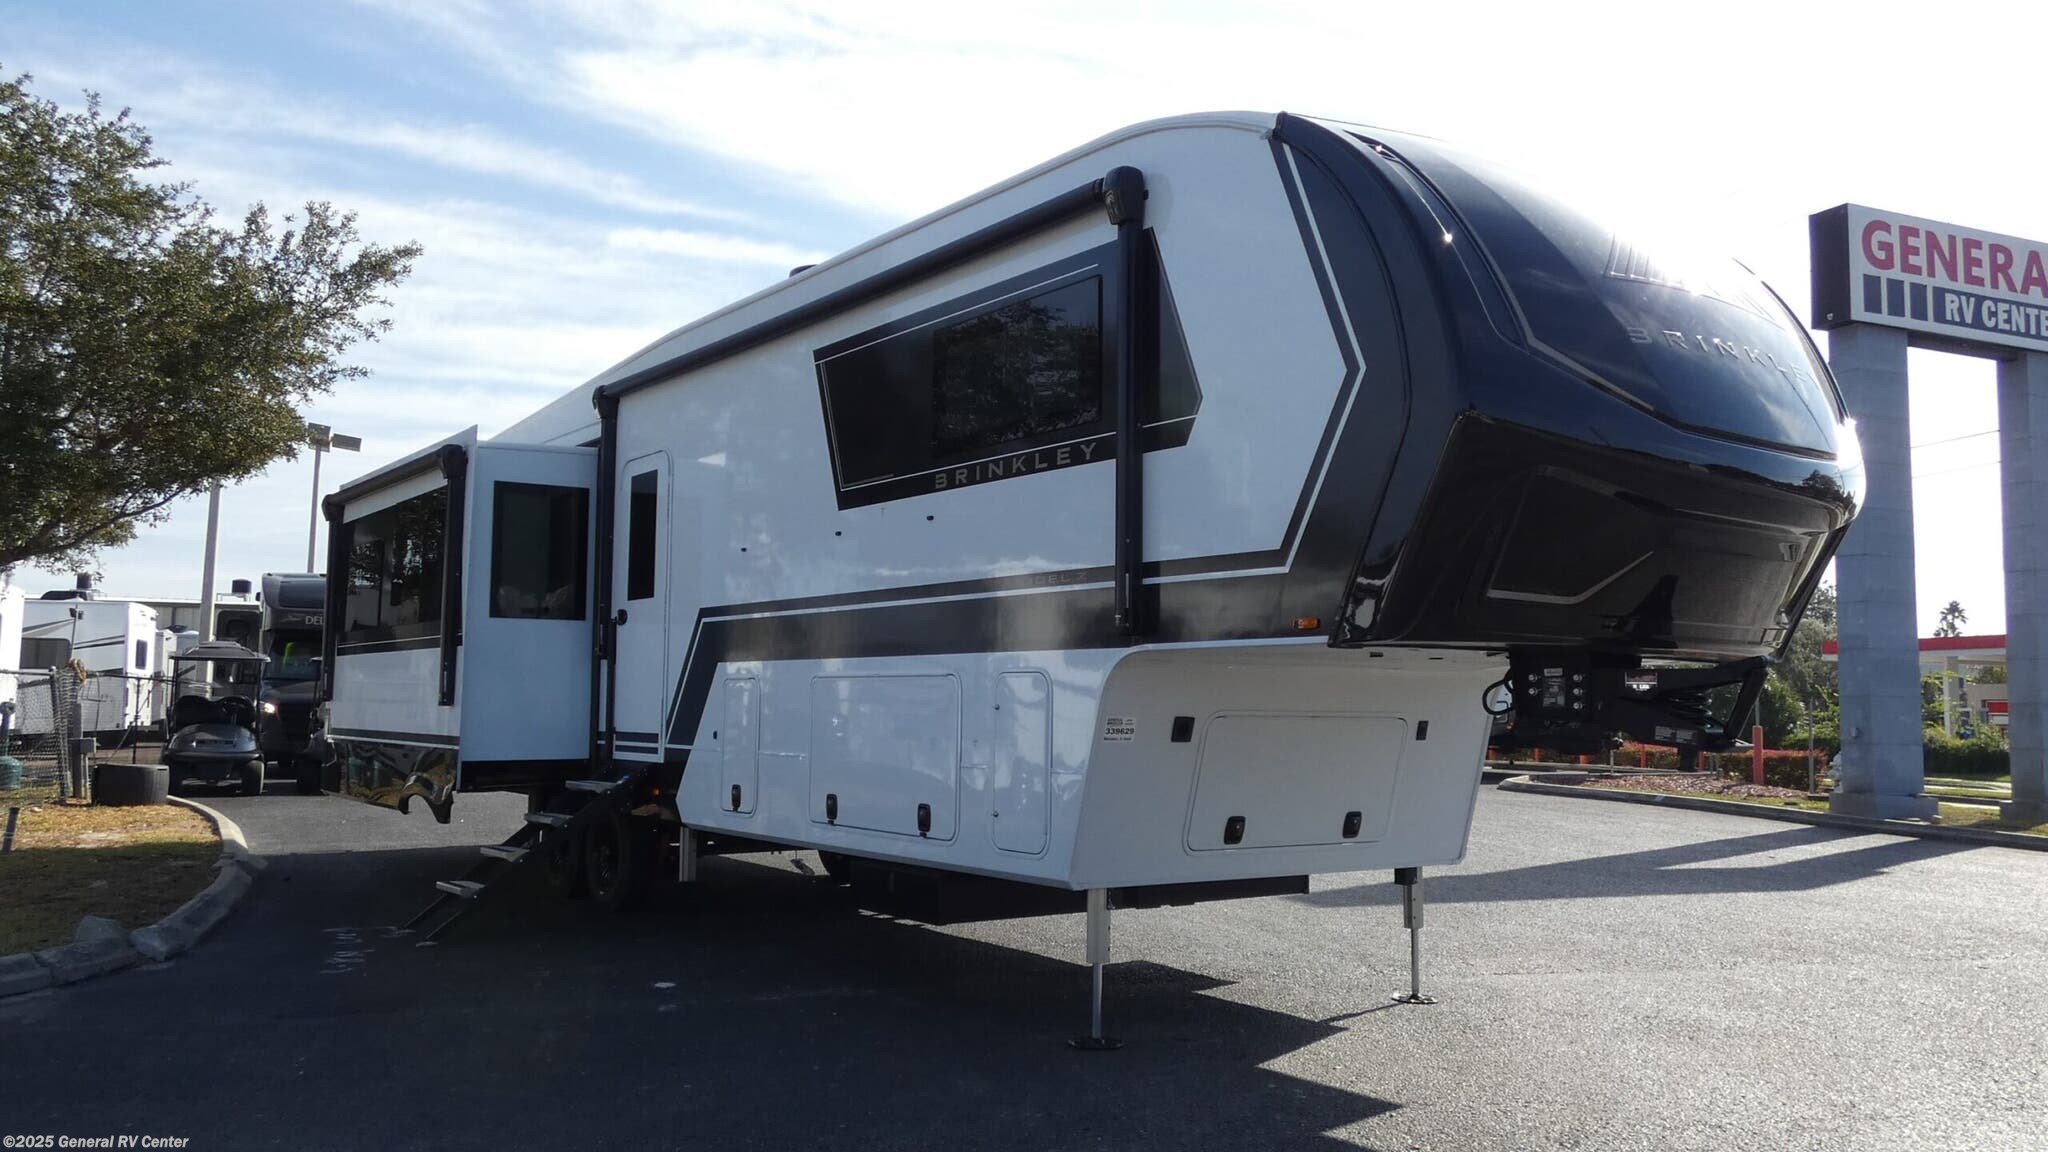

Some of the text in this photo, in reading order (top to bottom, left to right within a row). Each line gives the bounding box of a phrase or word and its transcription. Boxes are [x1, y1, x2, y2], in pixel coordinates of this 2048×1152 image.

[1862, 219, 2048, 299] GENERA
[1945, 292, 2048, 338] RV CENTE
[1627, 327, 1809, 383] BRINKLE
[935, 442, 1097, 489] BRINKLEY
[1104, 727, 1135, 735] 339629
